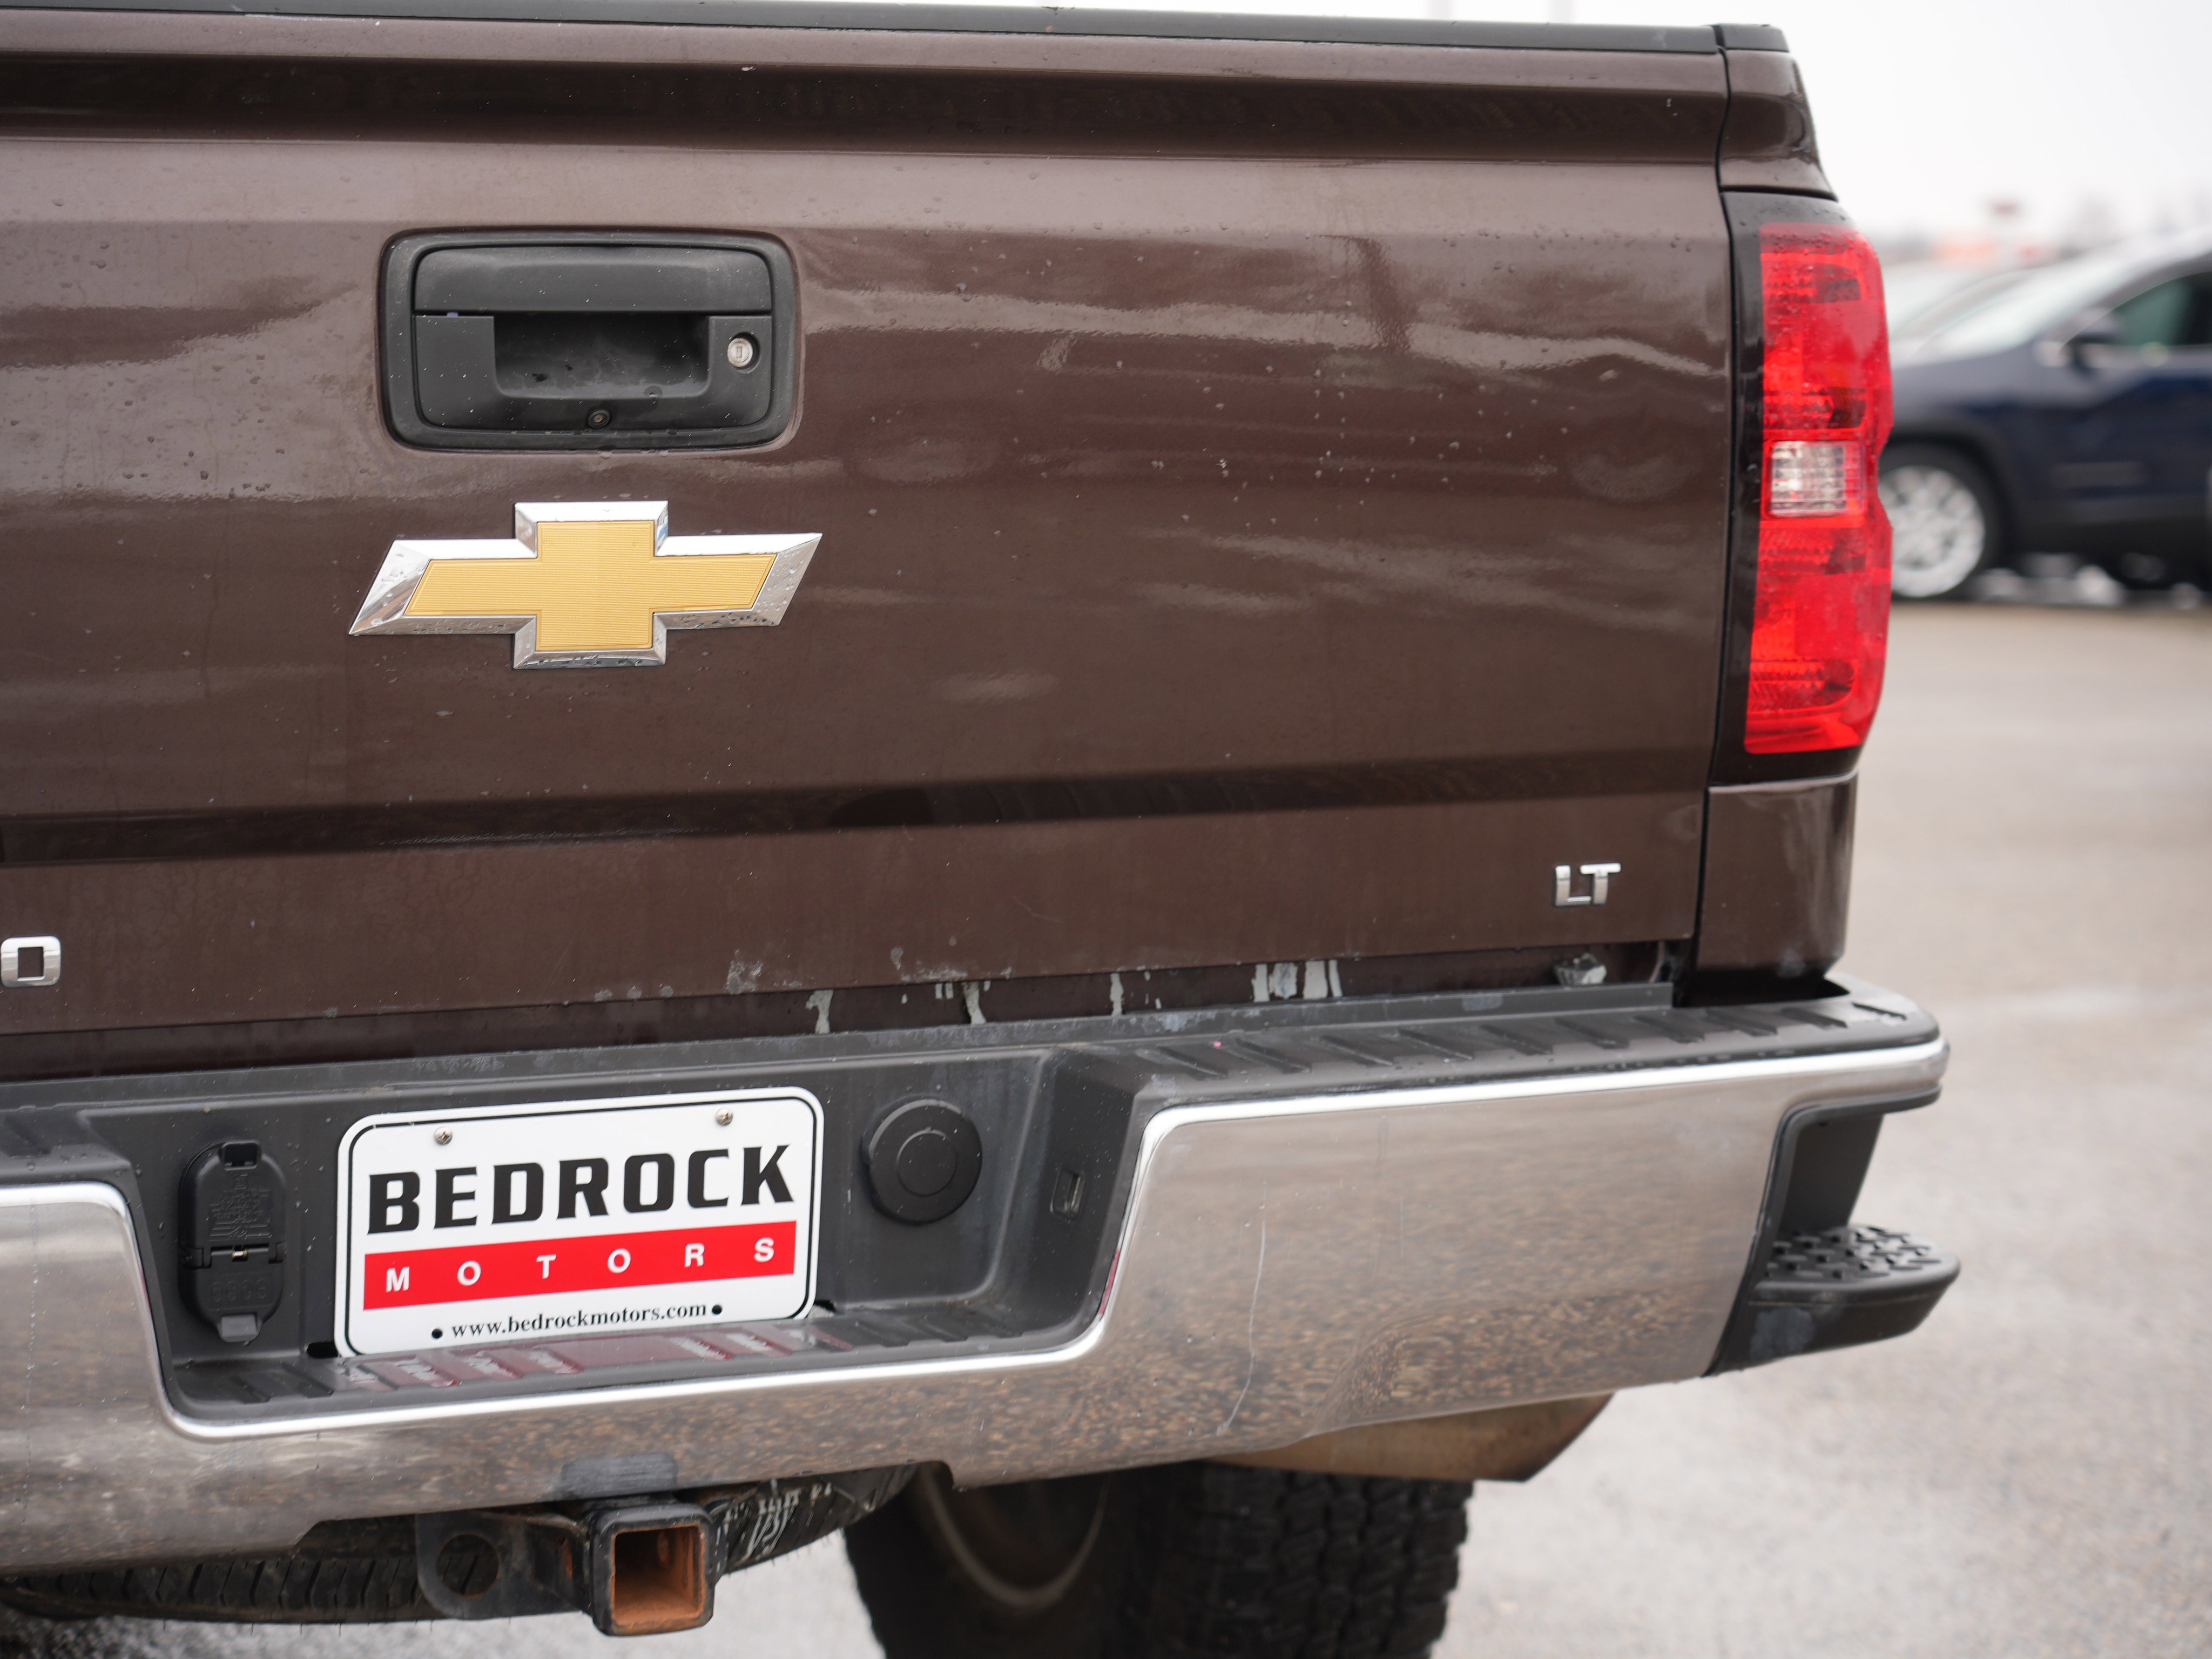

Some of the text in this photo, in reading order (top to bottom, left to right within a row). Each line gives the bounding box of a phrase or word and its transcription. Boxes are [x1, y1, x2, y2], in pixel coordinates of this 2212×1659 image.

[1554, 862, 1622, 907] LT
[367, 1144, 794, 1235] BEDROCK
[386, 1237, 775, 1292] MOTORS
[451, 1303, 707, 1338] www.bedrockmotors.com
